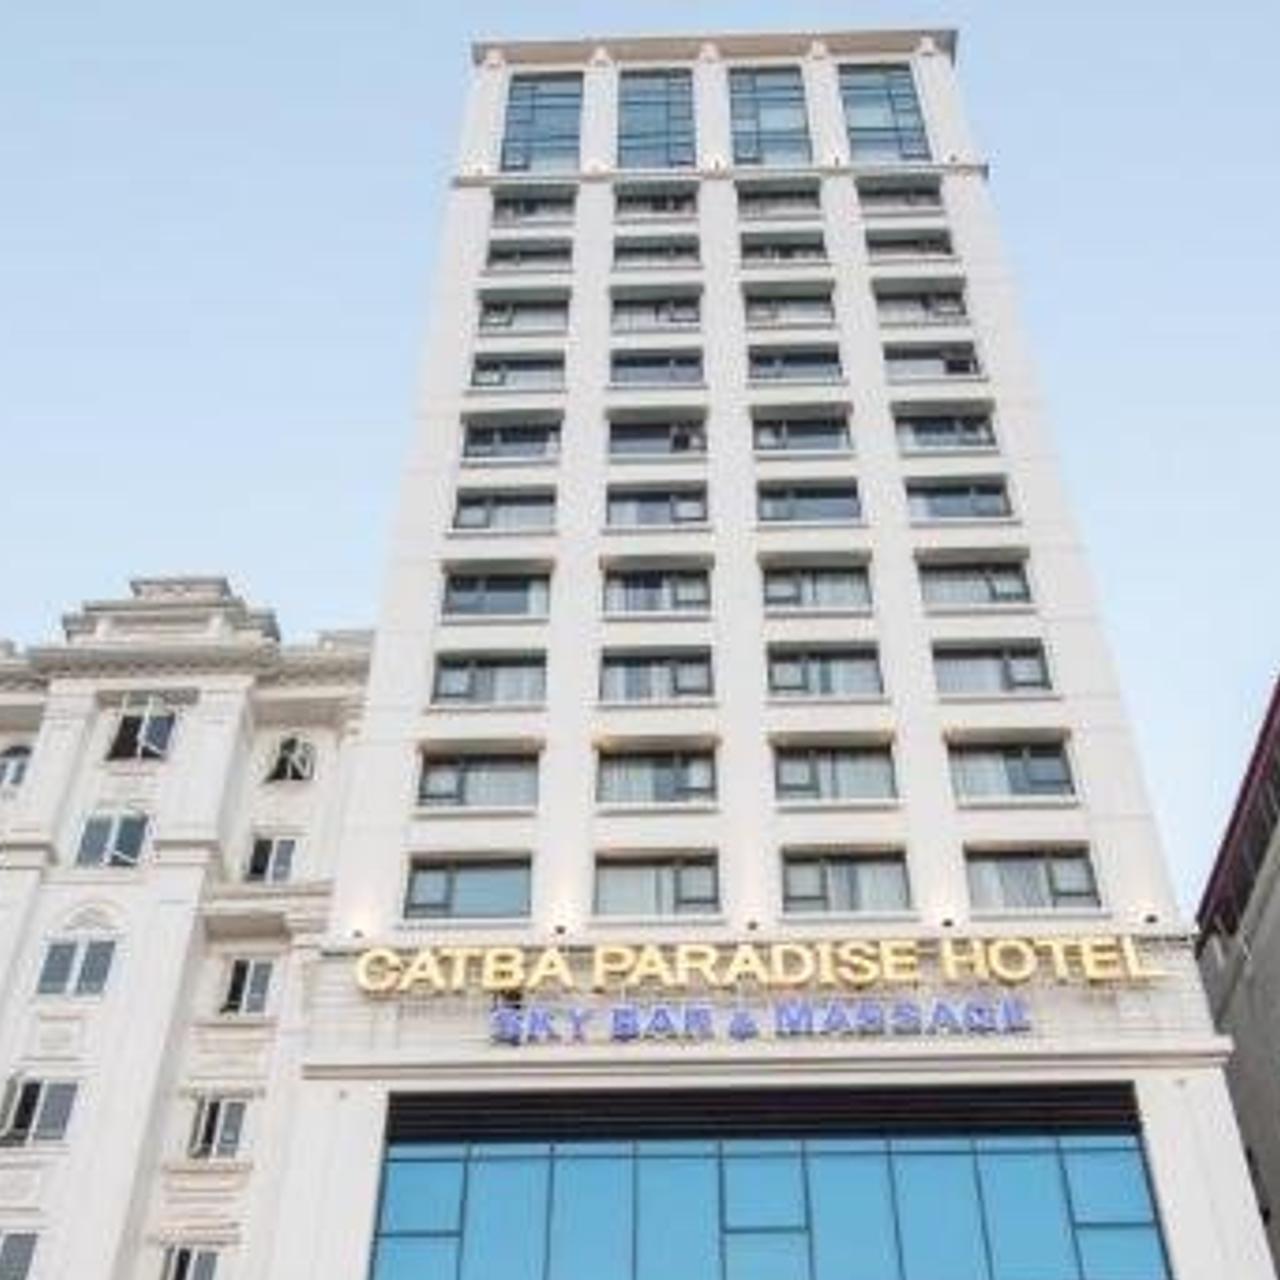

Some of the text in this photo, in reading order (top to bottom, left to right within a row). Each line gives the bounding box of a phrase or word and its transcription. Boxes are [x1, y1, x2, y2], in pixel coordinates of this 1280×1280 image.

[355, 935, 1169, 993] CATBA PARADISE HOTEL
[493, 996, 1033, 1045] SKY BAR & MASSAGE
